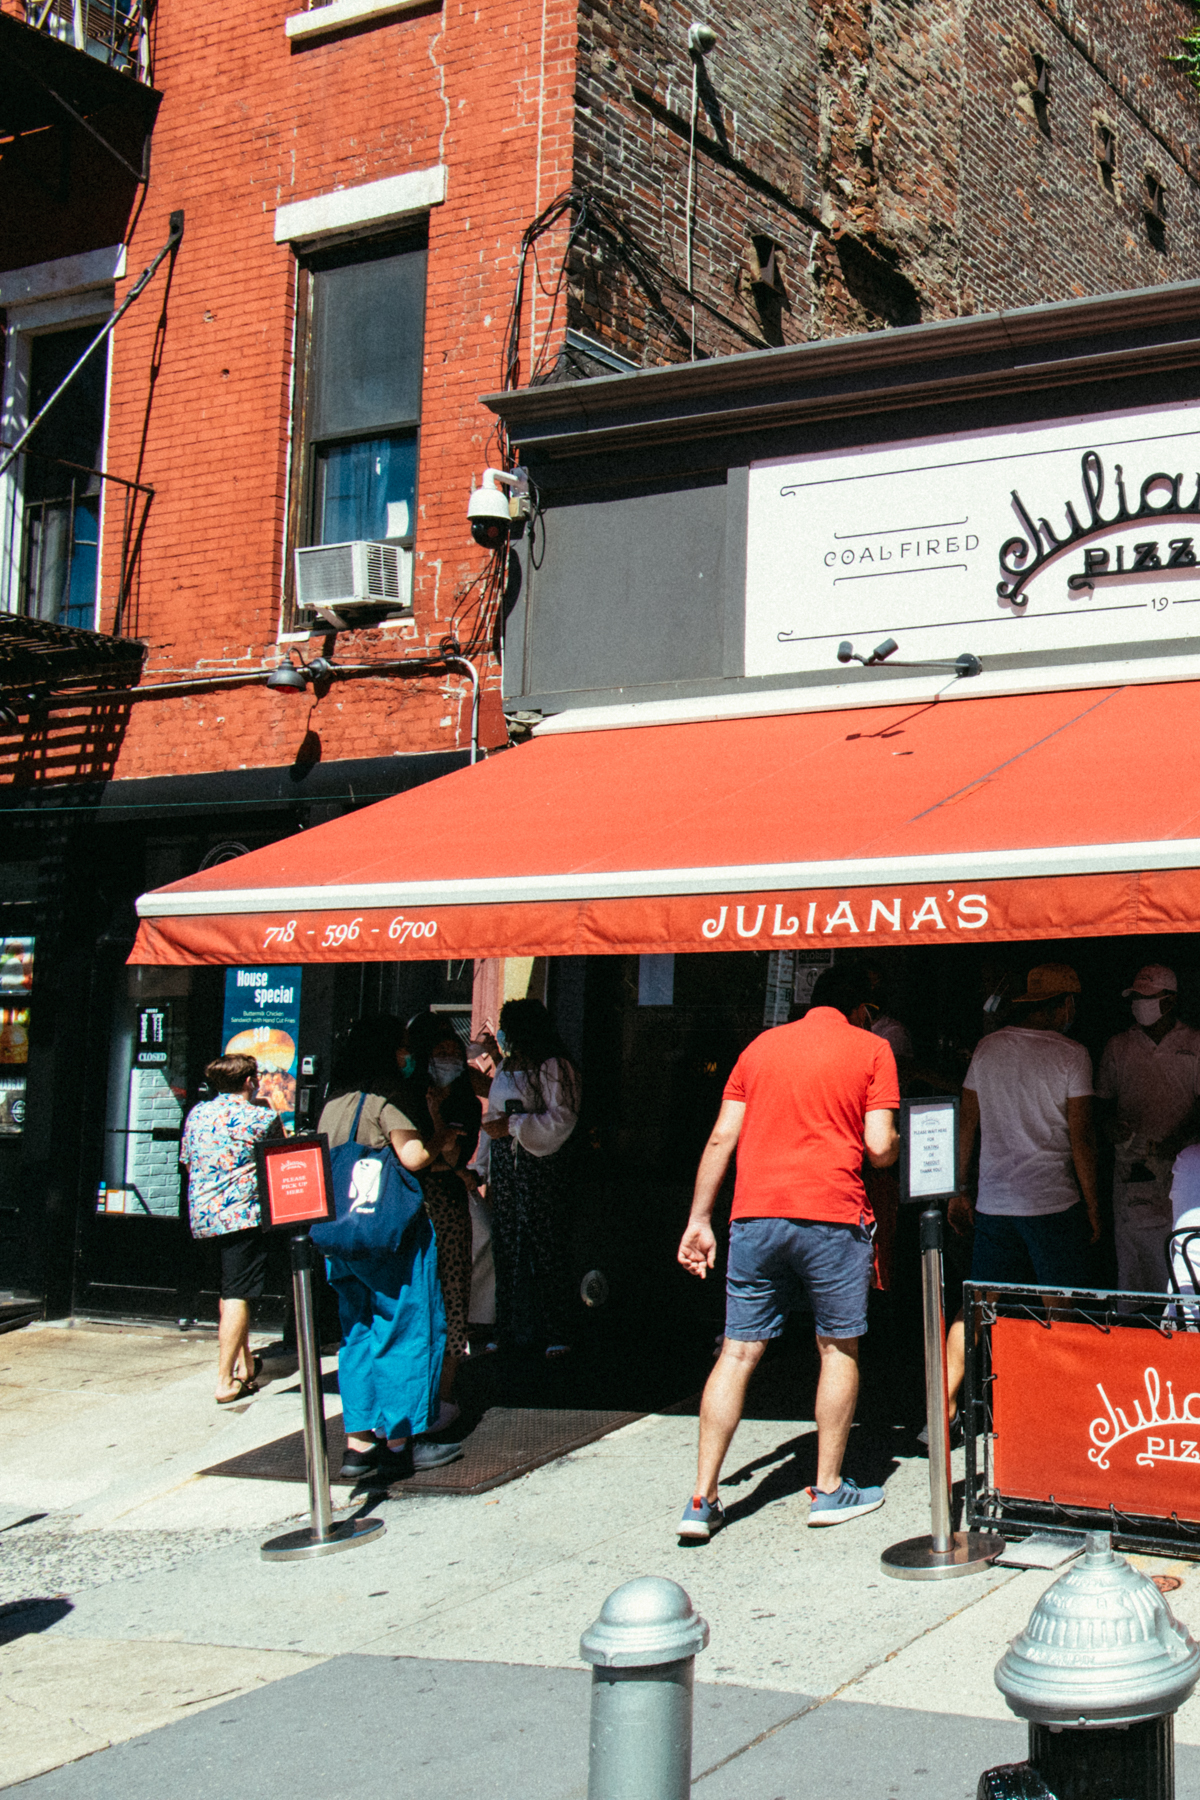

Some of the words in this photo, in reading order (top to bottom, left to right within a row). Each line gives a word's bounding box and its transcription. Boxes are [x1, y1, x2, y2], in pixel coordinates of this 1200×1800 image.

[823, 542, 893, 568] COAL
[899, 533, 981, 559] FIRED
[1150, 597, 1170, 612] 19
[701, 888, 990, 940] JULIANA'S
[263, 919, 297, 948] 718
[321, 917, 363, 947] 596
[388, 915, 438, 944] 6700
[236, 970, 269, 987] House
[254, 985, 294, 1008] special
[138, 1052, 167, 1062] CLOSED
[282, 1175, 307, 1183] PLEASE
